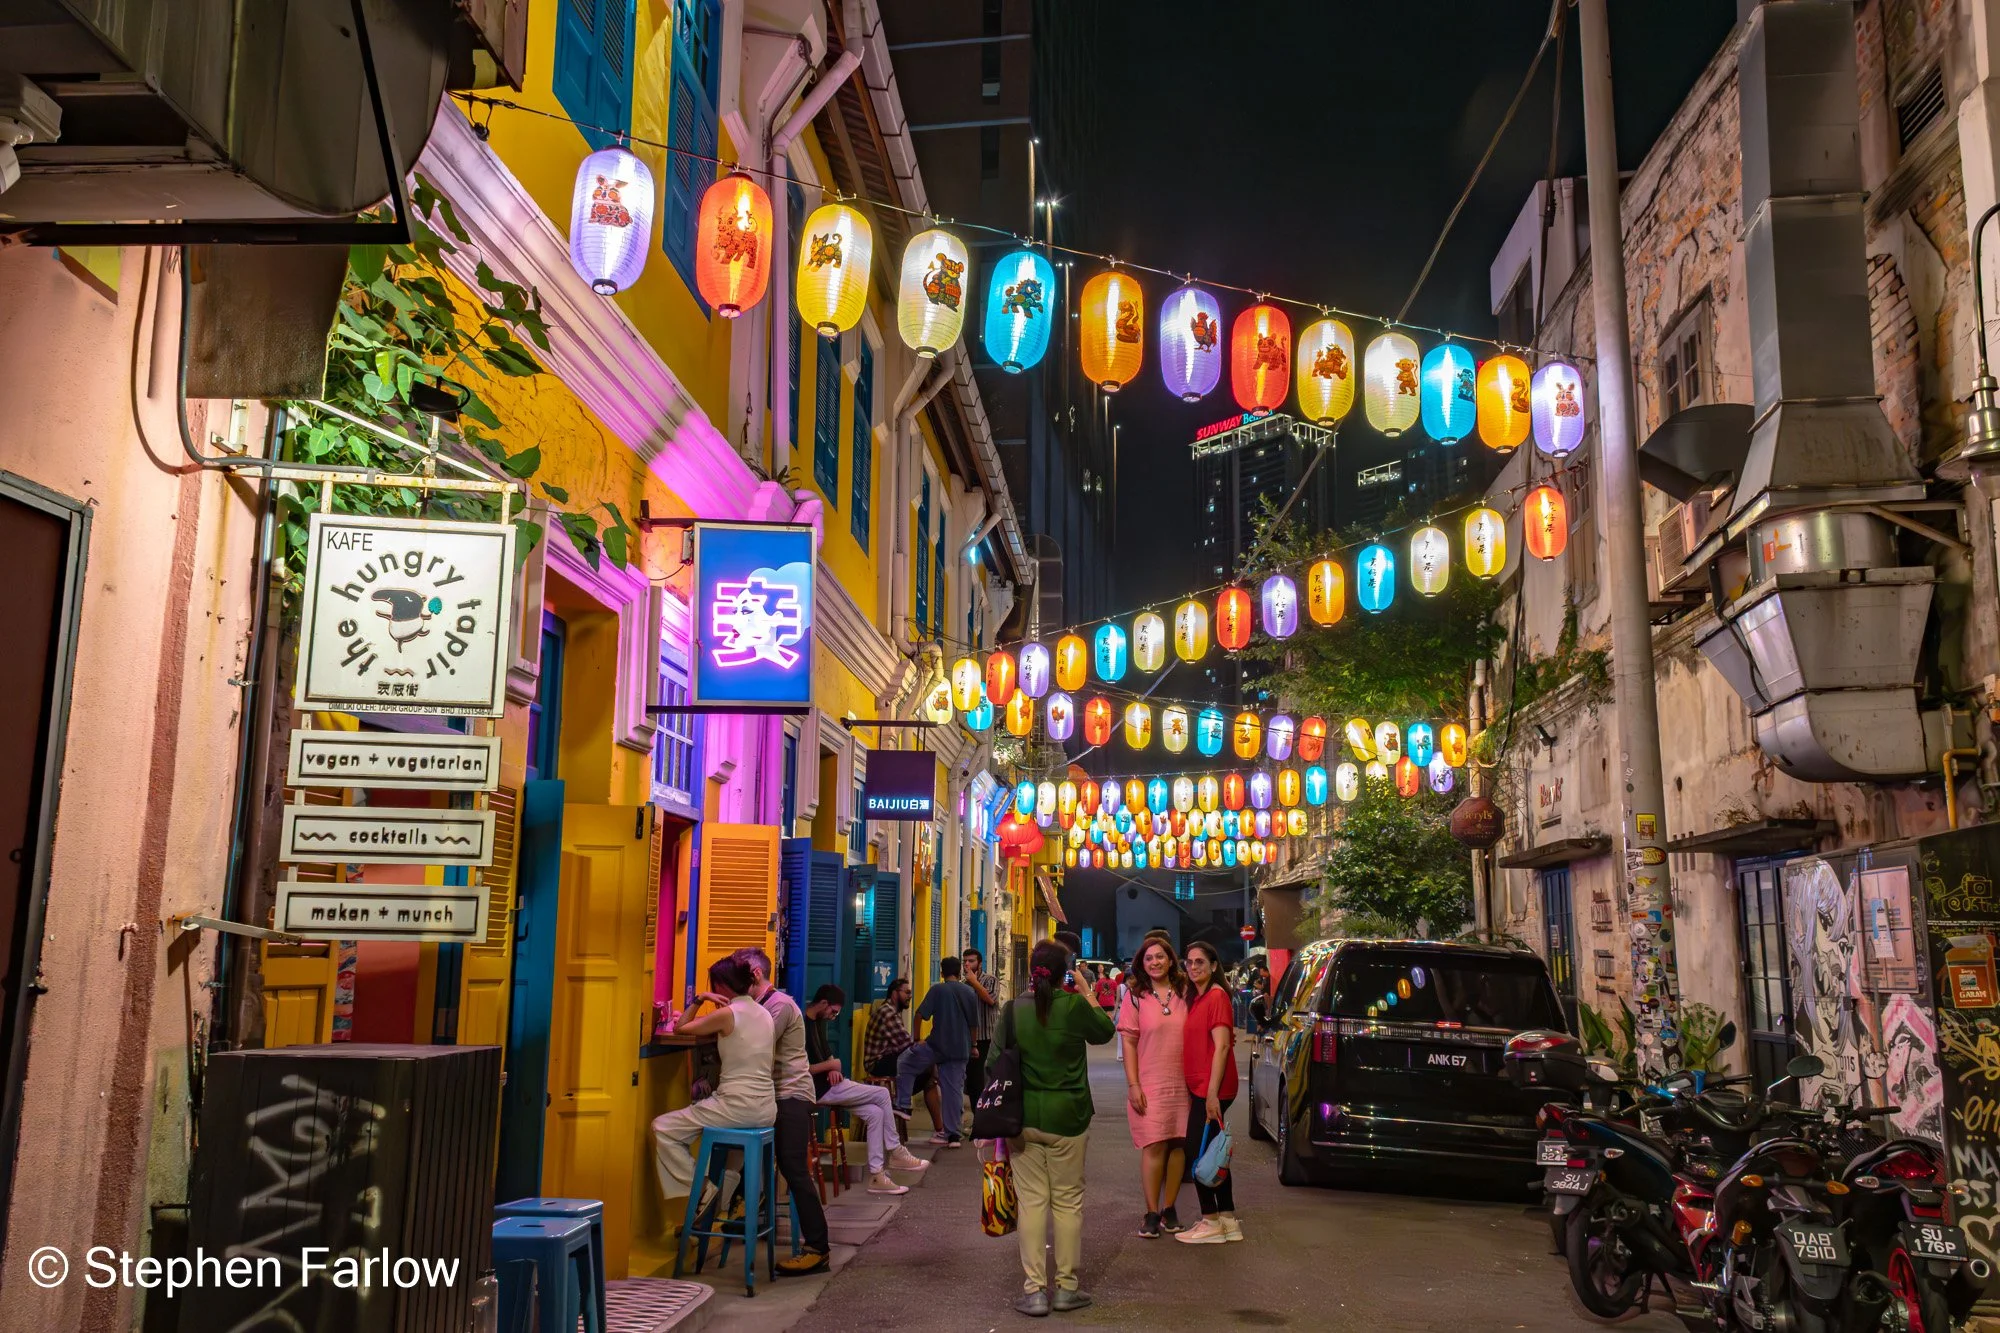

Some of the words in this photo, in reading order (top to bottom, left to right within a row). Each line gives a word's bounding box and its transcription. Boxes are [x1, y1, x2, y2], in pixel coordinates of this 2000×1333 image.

[1196, 414, 1243, 441] SUNWAY
[327, 531, 374, 552] KAFE
[330, 550, 465, 603] hungry
[338, 617, 379, 677] the
[426, 598, 482, 679] tapir
[379, 704, 398, 712] TAPIR
[399, 704, 422, 713] GROUP
[306, 753, 360, 770] vegan
[387, 755, 483, 772] vegetarian
[349, 827, 428, 846] cocktails
[311, 903, 370, 921] makan
[397, 905, 453, 922] munch
[1421, 1030, 1470, 1040] ZEEKR
[1427, 1053, 1450, 1066] ANK
[1451, 1055, 1467, 1067] 67
[1564, 1173, 1581, 1183] SU
[1793, 1231, 1832, 1246] QAB
[1921, 1228, 1943, 1242] SU
[1914, 1238, 1957, 1254] 176P
